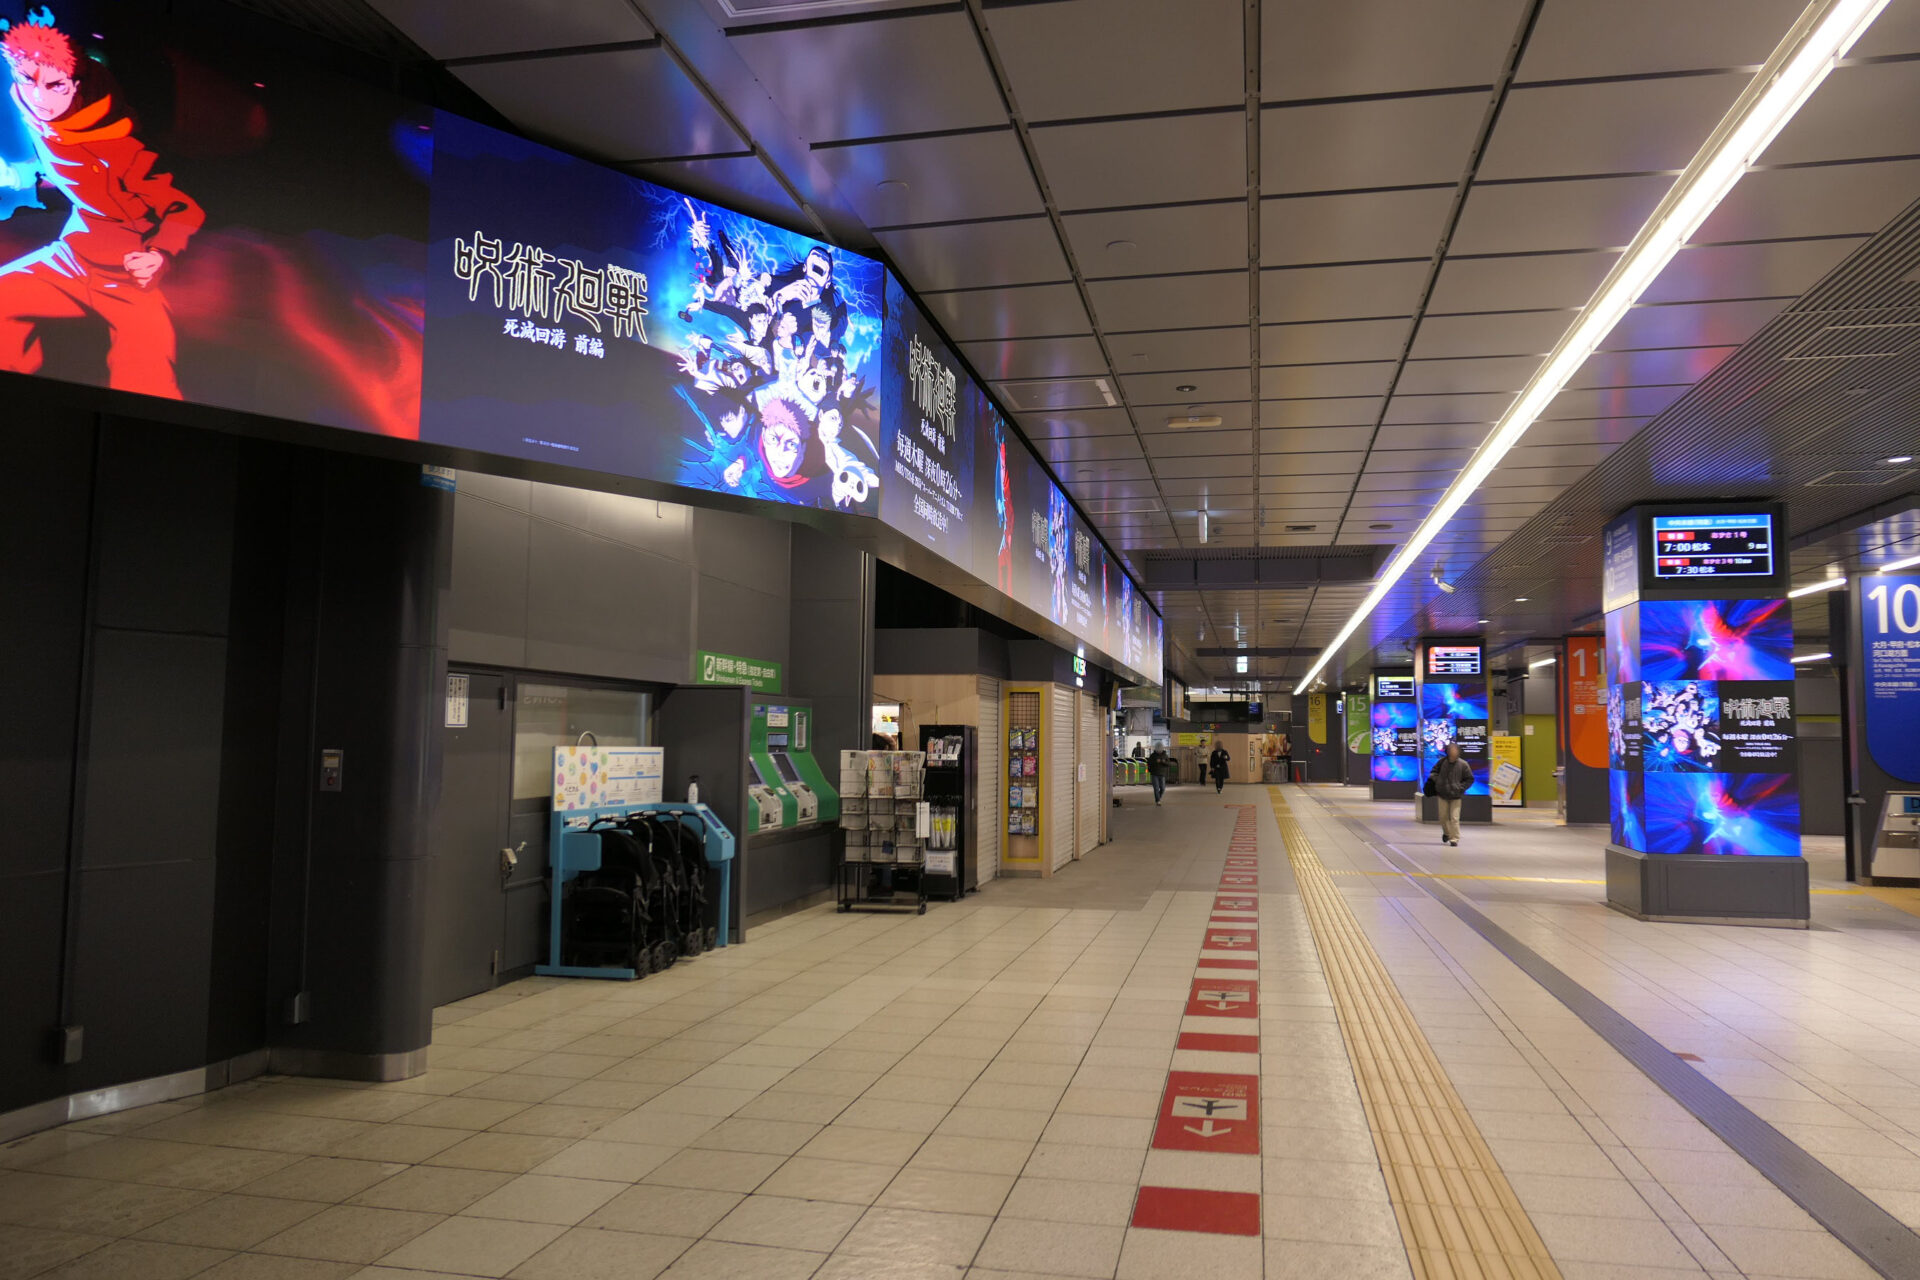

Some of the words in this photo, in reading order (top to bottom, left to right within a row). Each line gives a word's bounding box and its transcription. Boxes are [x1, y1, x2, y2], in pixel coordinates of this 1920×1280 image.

[502, 318, 567, 350] 死滅回游
[574, 334, 605, 359] 前編
[896, 428, 925, 474] 毎週木曜
[1664, 543, 1691, 552] 7:00
[1692, 542, 1711, 551] 松本
[1676, 566, 1698, 574] 7:30
[1867, 583, 1920, 634] 10
[1572, 647, 1605, 677] 11
[1348, 696, 1367, 712] 15
